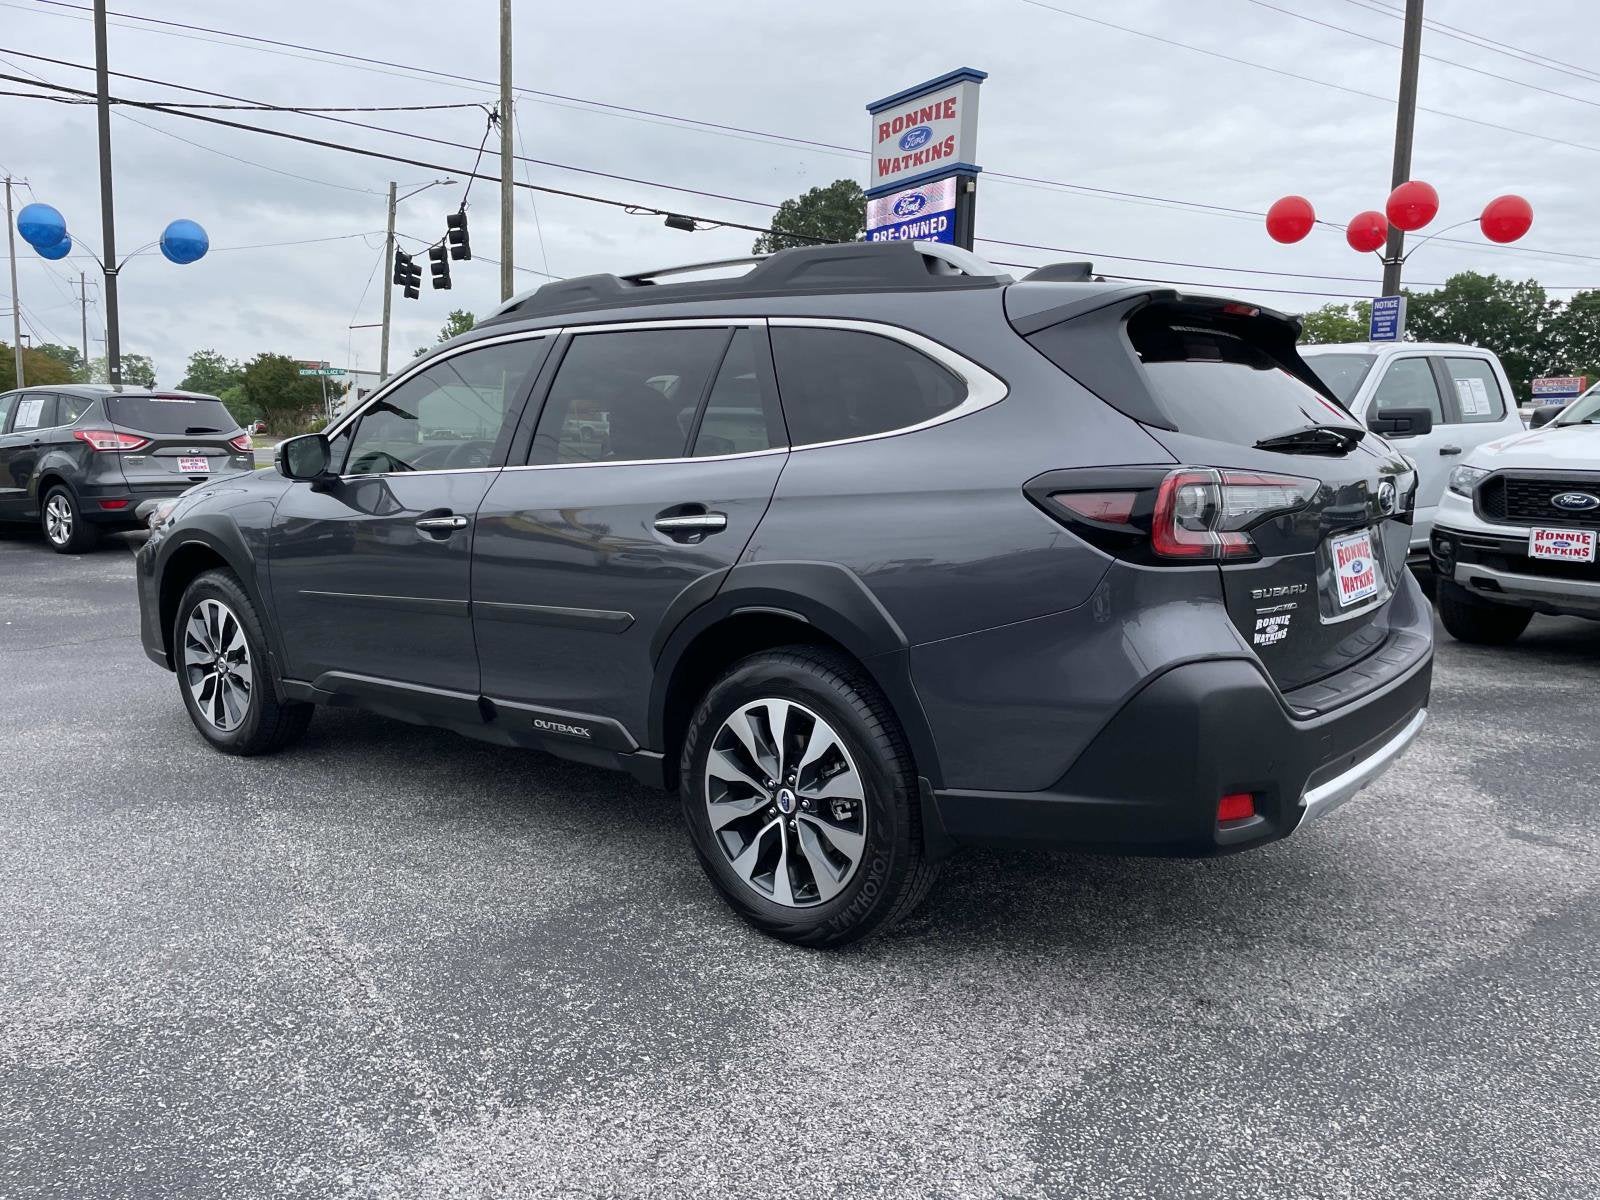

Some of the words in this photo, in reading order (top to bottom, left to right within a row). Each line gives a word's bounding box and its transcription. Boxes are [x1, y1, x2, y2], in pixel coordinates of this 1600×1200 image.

[878, 97, 957, 144] RONNIE
[904, 130, 927, 149] Ford
[878, 135, 955, 177] WATKINS
[872, 216, 948, 242] PRE-OWNED
[1374, 300, 1398, 309] NOTICE
[1534, 379, 1579, 387] EXPRESS
[1560, 495, 1588, 506] Ford
[1535, 531, 1591, 545] RONNIE
[1337, 541, 1371, 569] RONNIE
[1534, 543, 1590, 557] WATKINS
[1340, 565, 1375, 595] WATKINS
[1251, 583, 1308, 599] SUBARU
[1255, 614, 1292, 631] RONNIE
[1253, 627, 1288, 645] WATKINS
[533, 719, 591, 737] OUTBACK
[828, 850, 890, 930] YOKOHAMA
